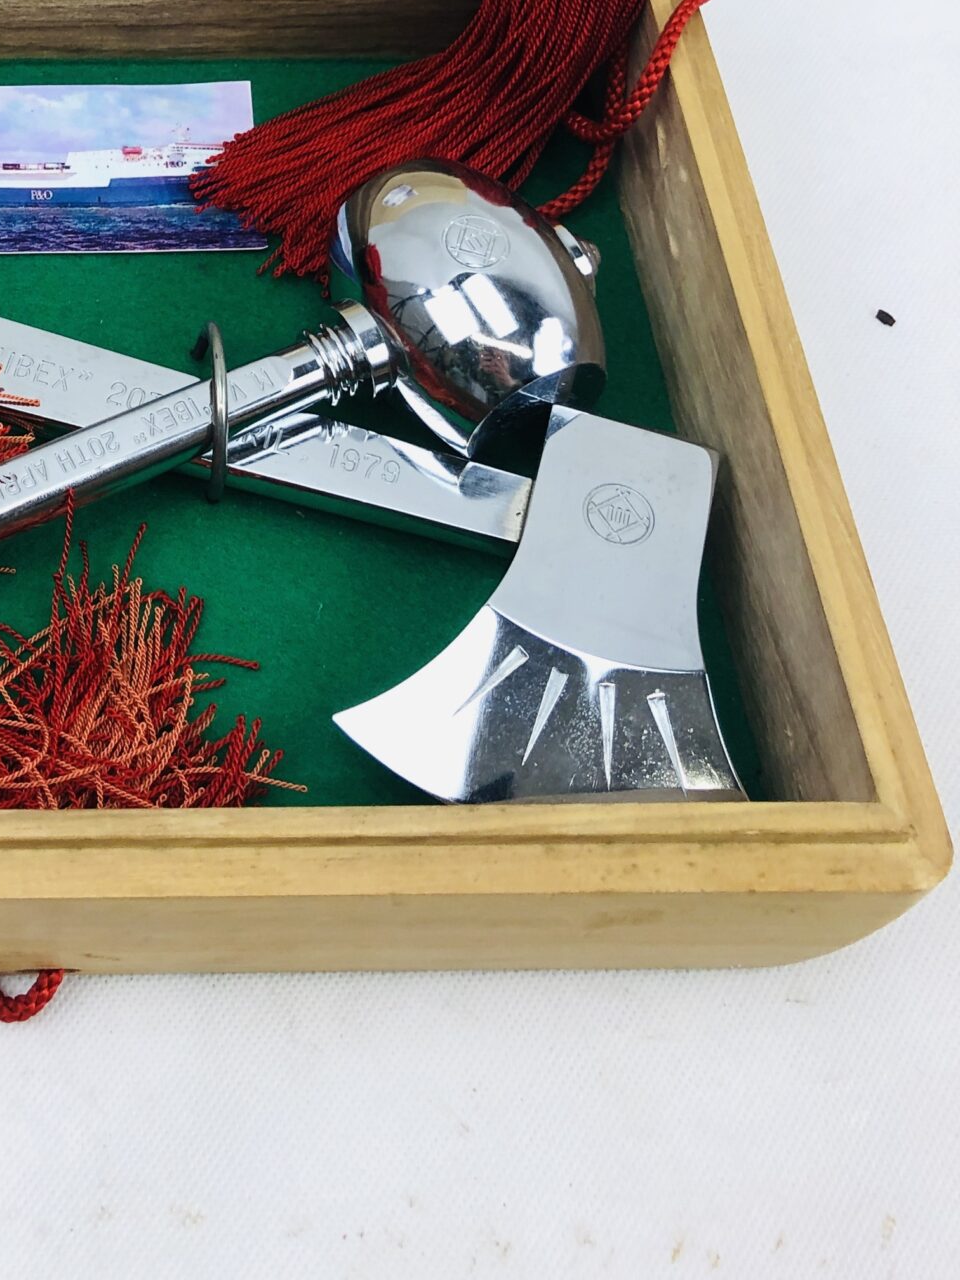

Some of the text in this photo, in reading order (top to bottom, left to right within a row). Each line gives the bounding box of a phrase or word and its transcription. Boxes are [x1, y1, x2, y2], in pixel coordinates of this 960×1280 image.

[30, 189, 53, 201] P&O
[53, 430, 121, 474] 20TH
[328, 443, 401, 484] 1979
